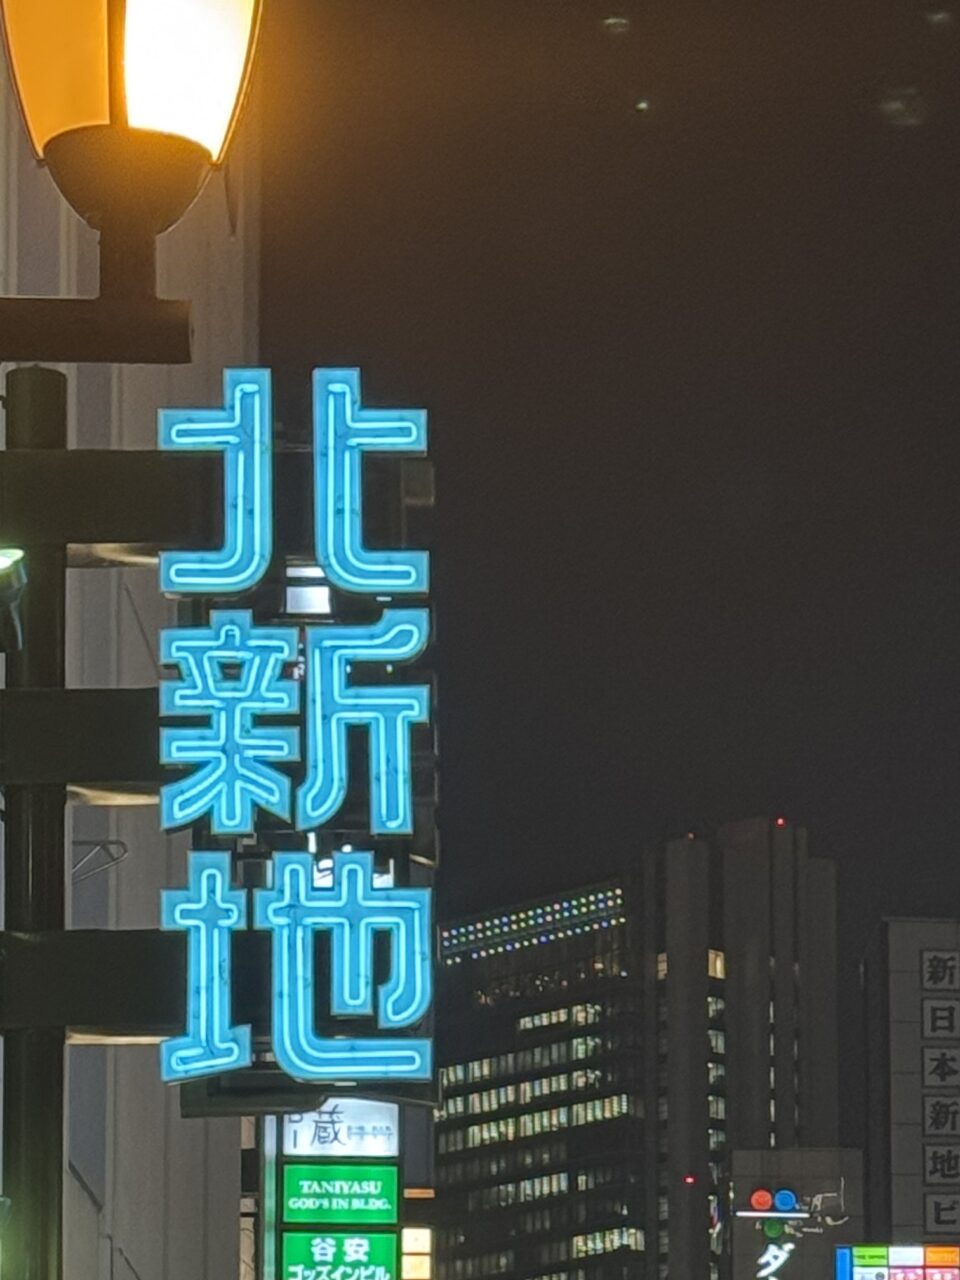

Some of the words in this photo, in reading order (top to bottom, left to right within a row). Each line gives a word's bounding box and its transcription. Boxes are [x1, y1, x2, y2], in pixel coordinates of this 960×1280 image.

[158, 367, 432, 1083] 北新地
[299, 1180, 384, 1195] TANIYASU
[288, 1198, 331, 1210] GOD'S
[332, 1198, 350, 1210] IN
[351, 1198, 393, 1211] BLDG.
[310, 1237, 371, 1263] 谷安
